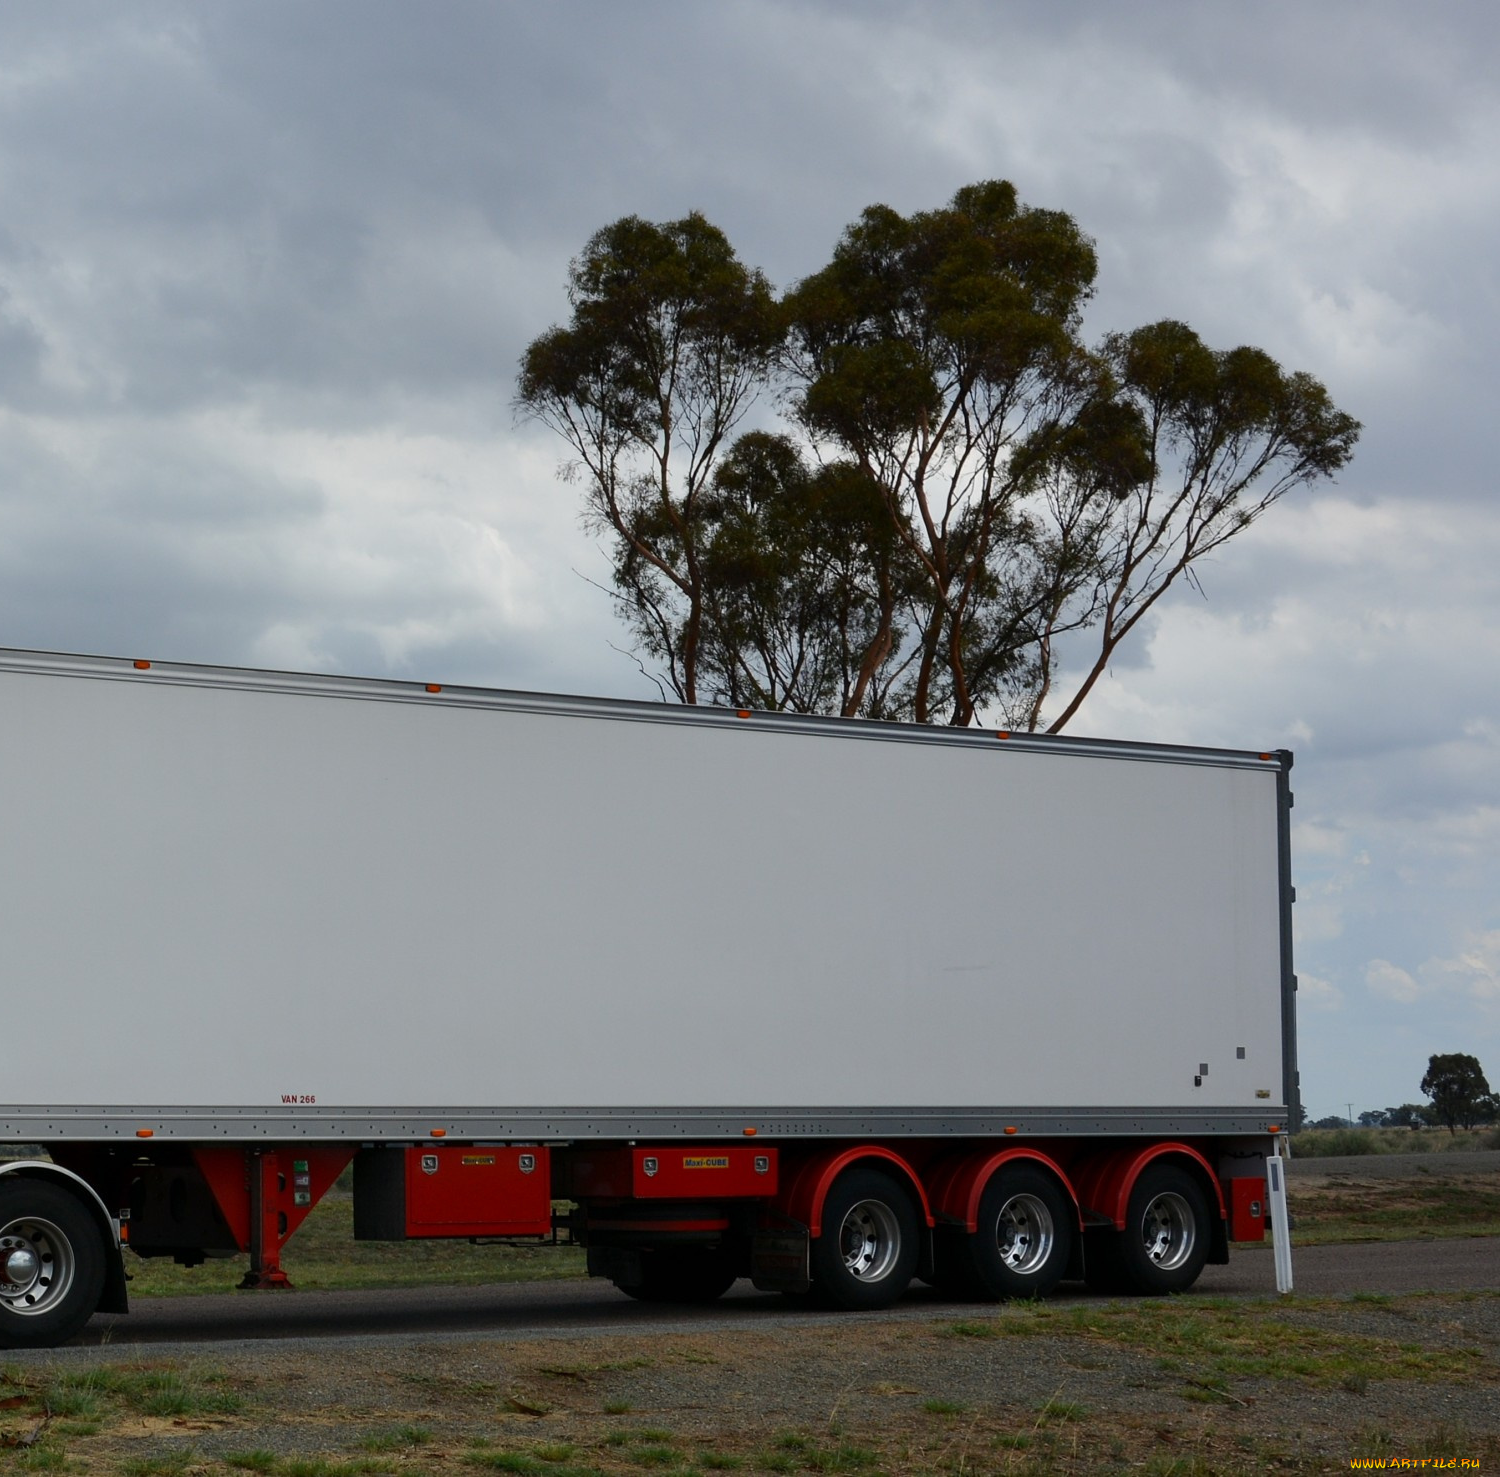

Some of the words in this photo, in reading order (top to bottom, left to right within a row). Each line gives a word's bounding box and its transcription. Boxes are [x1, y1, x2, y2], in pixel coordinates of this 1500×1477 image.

[281, 1094, 298, 1104] VAN
[299, 1095, 316, 1104] 266
[684, 1158, 727, 1167] Maxi-CUBE
